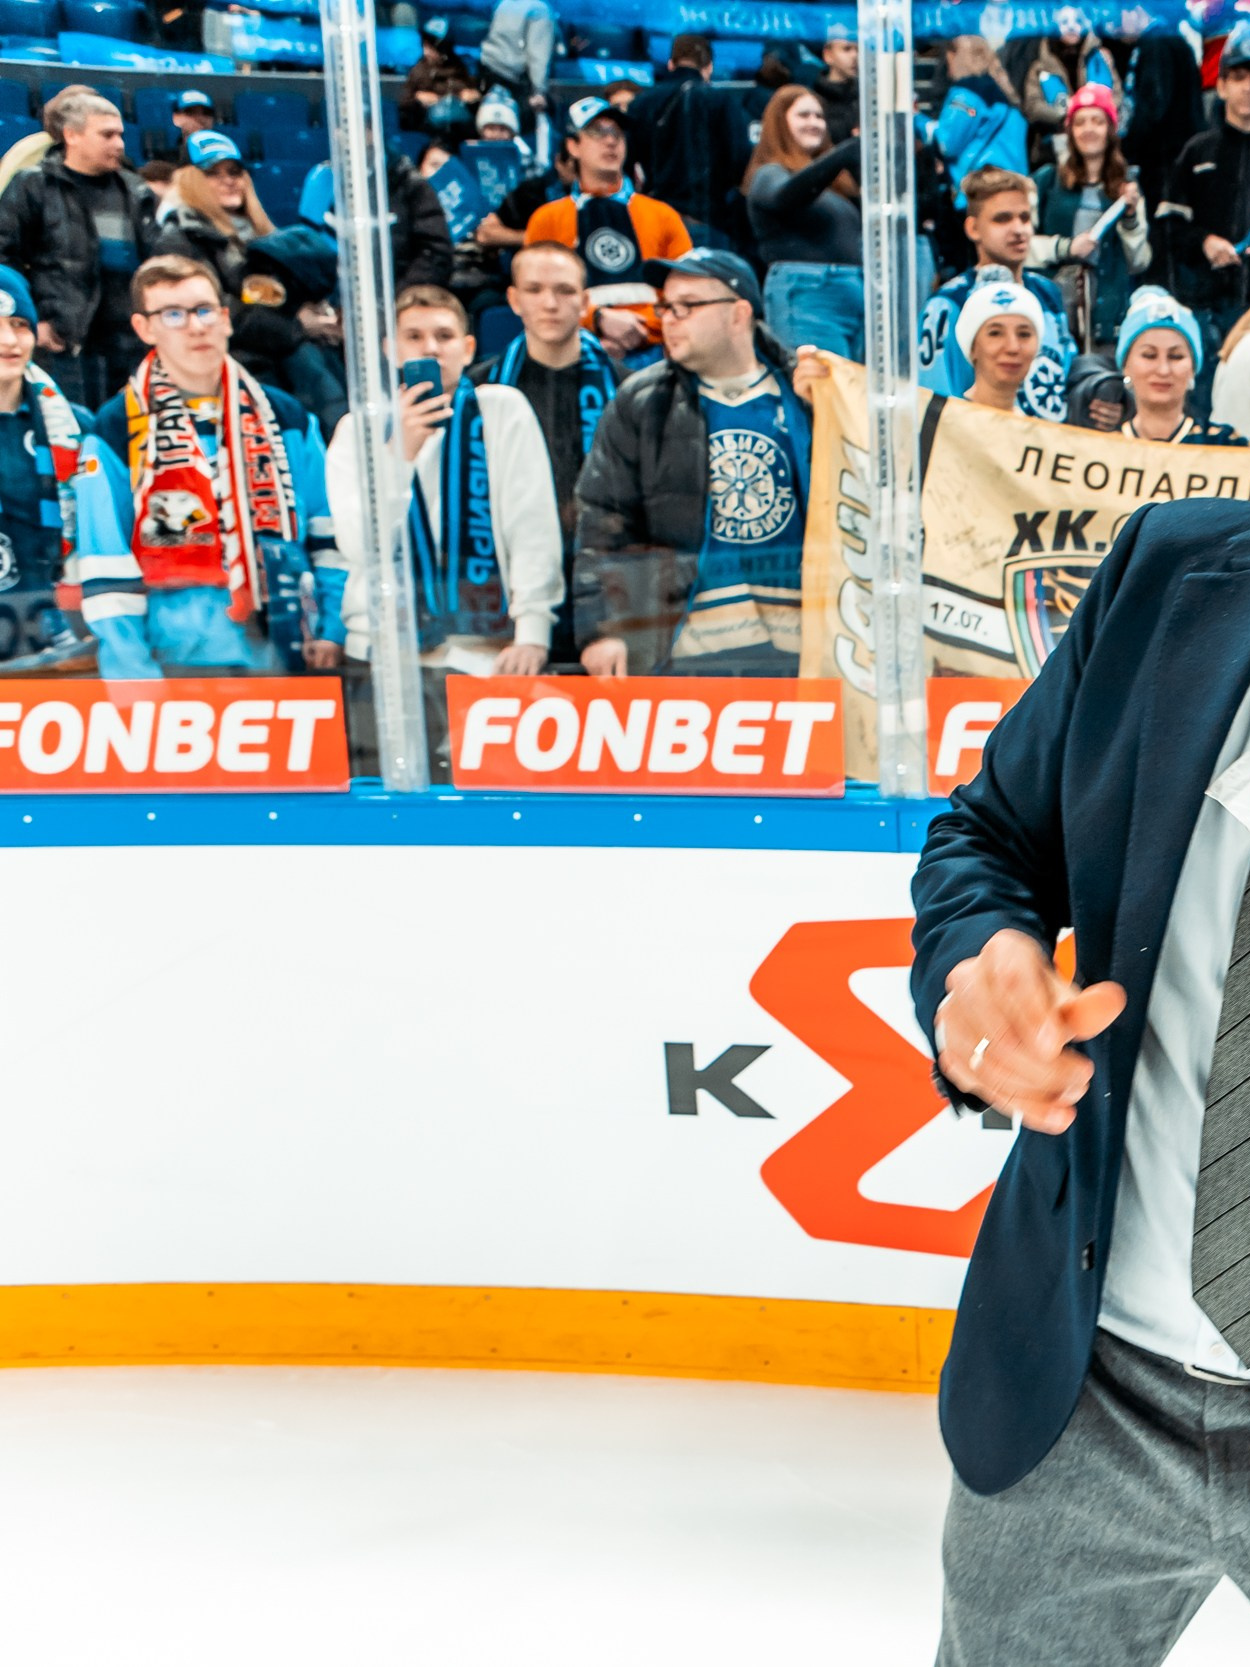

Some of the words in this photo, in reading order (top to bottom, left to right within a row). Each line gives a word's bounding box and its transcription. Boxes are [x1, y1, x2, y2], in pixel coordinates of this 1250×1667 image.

[709, 434, 776, 465] ИБИРЬ
[1004, 509, 1131, 558] ХК.
[929, 602, 988, 636] 17.07.
[460, 697, 836, 775] FONBET
